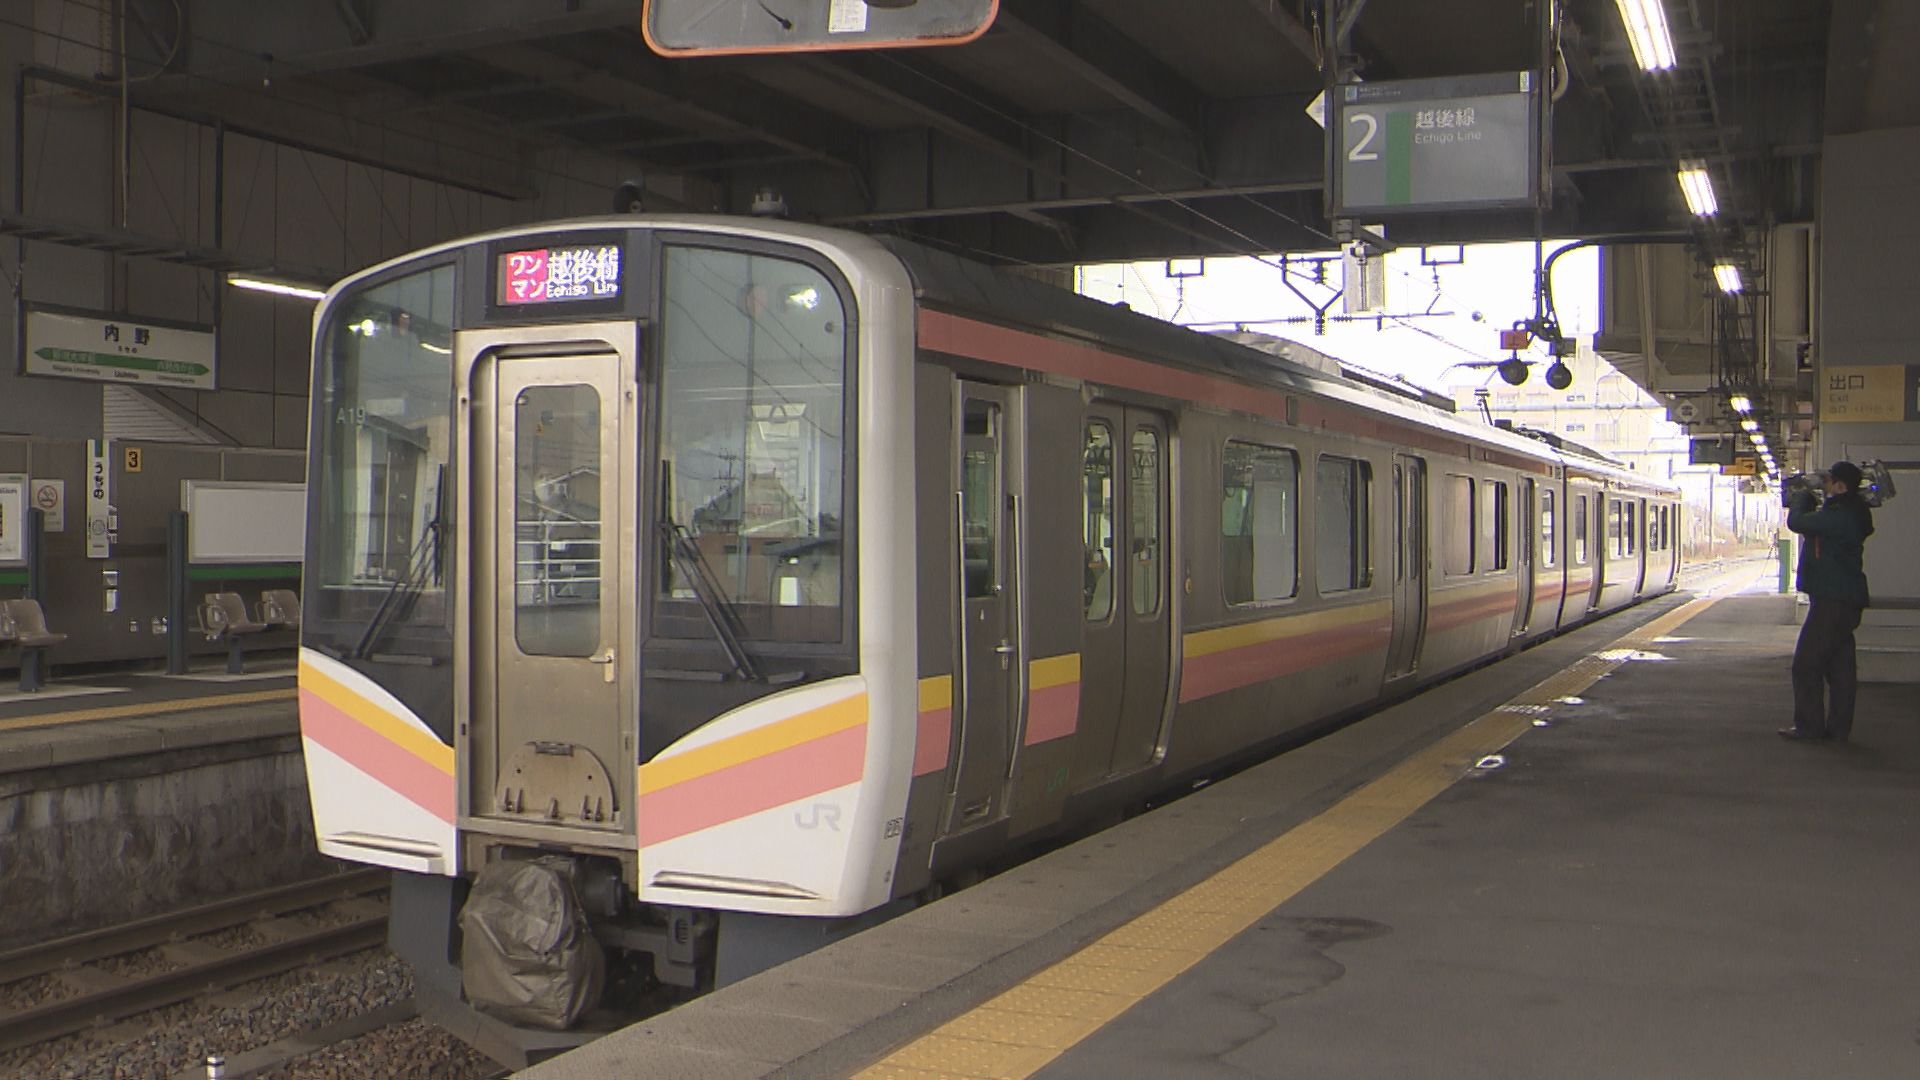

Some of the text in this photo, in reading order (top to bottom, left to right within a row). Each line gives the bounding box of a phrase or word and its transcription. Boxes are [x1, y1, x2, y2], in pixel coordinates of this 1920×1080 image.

[1415, 107, 1475, 129] 越後線
[1348, 112, 1379, 162] 2
[1415, 131, 1482, 145] Echigo Line
[510, 255, 542, 276] ワン
[511, 279, 544, 298] マン
[104, 323, 150, 346] 内野
[1829, 374, 1864, 390] 出口
[336, 407, 366, 425] A19
[128, 450, 138, 468] 3
[794, 803, 842, 831] JR
